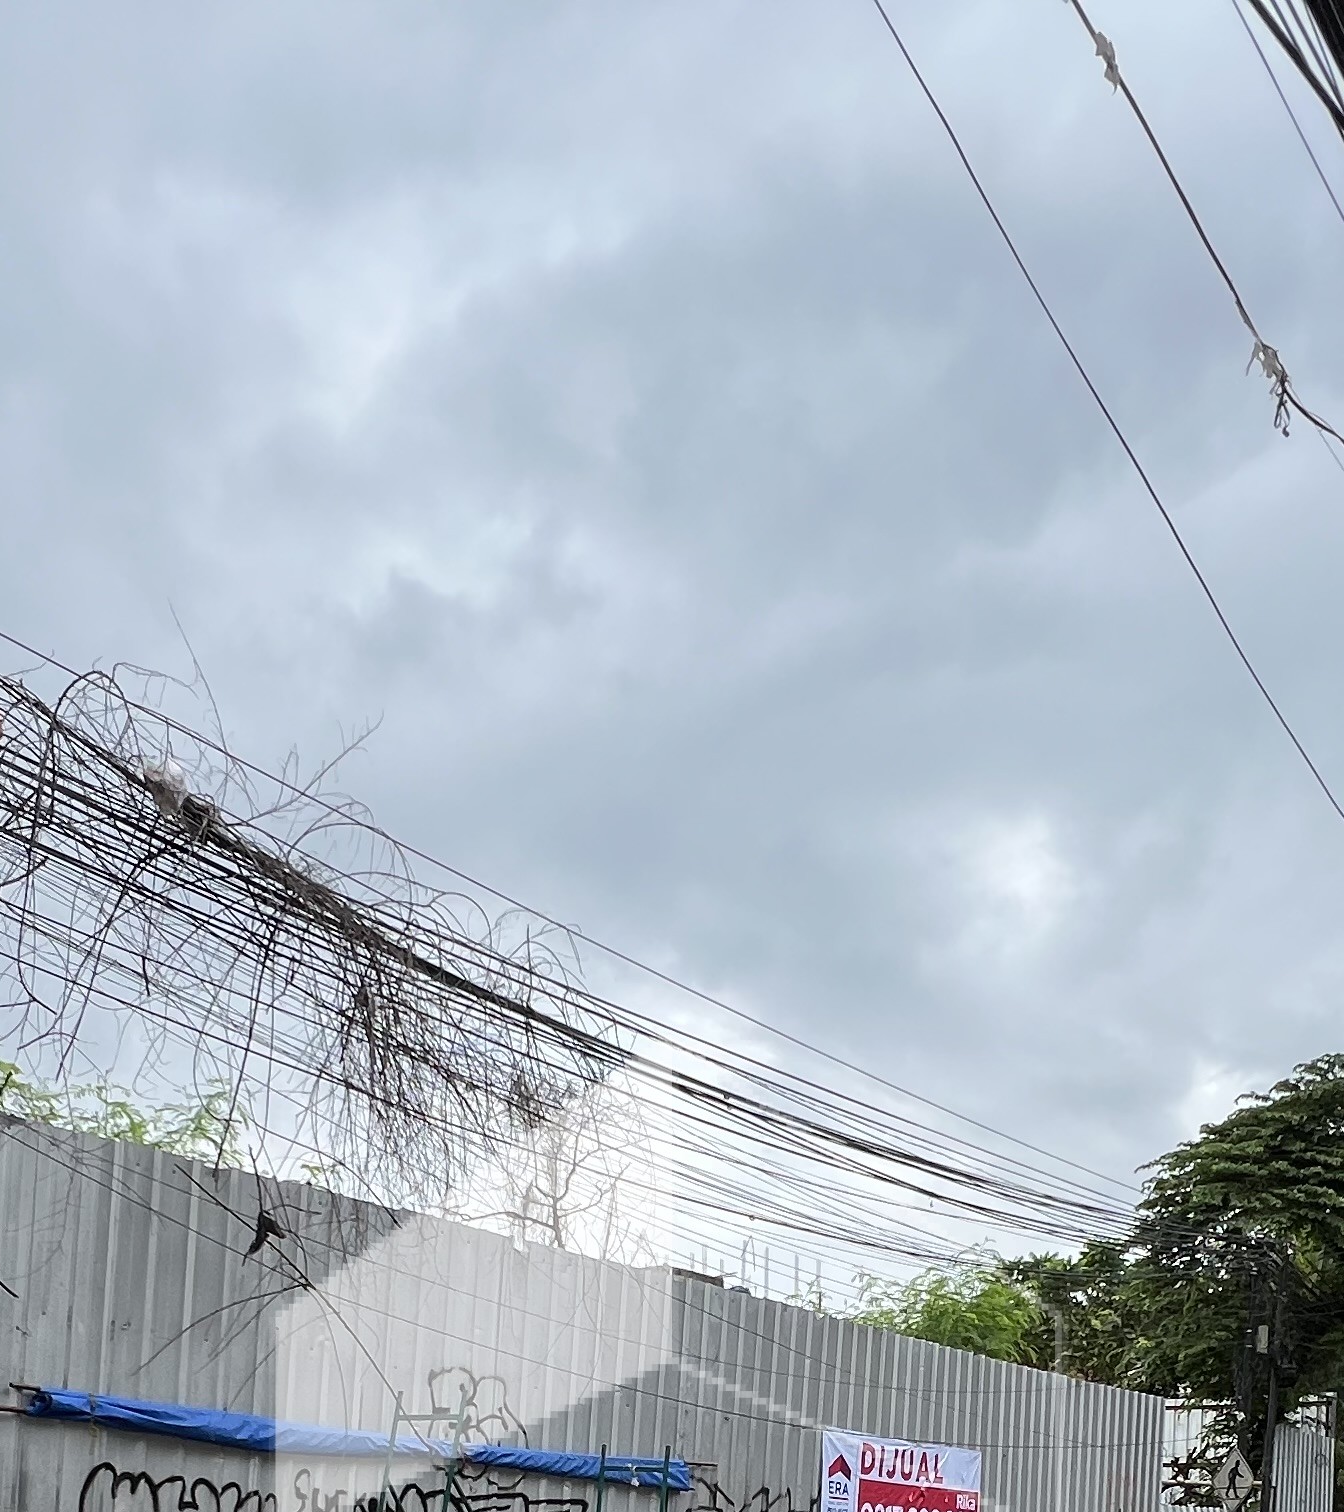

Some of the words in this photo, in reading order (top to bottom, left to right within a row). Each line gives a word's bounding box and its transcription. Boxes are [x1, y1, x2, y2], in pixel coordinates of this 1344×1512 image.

[860, 1441, 944, 1485] DIJUAL
[828, 1480, 850, 1496] ERA
[955, 1493, 976, 1512] Rika
